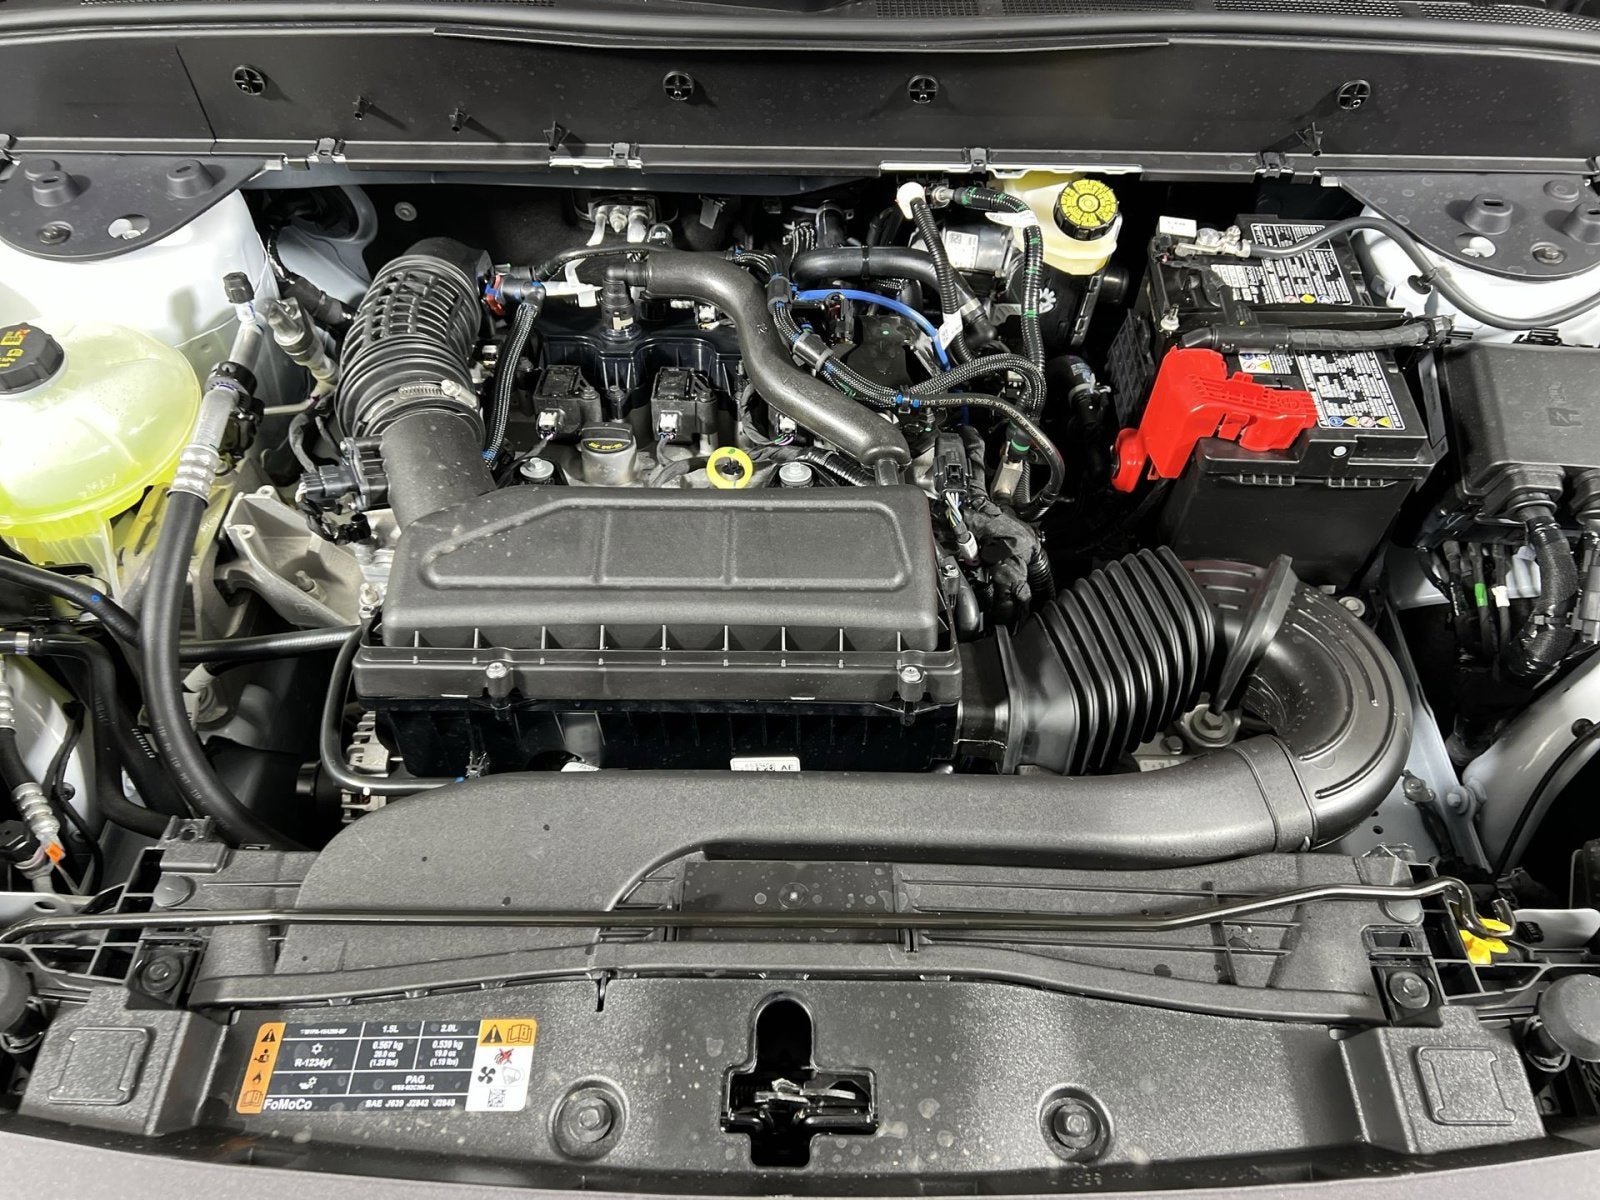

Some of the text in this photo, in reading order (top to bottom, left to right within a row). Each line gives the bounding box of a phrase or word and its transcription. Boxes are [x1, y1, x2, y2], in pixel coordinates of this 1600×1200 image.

[382, 1025, 399, 1033] 1.5L
[440, 1024, 459, 1033] 2.0L
[392, 1040, 404, 1051] kg
[453, 1040, 464, 1050] kg
[294, 1057, 334, 1069] R-1234yf
[405, 1075, 426, 1084] PAG
[263, 1099, 313, 1110] FoMoCo
[365, 1099, 383, 1108] SAE
